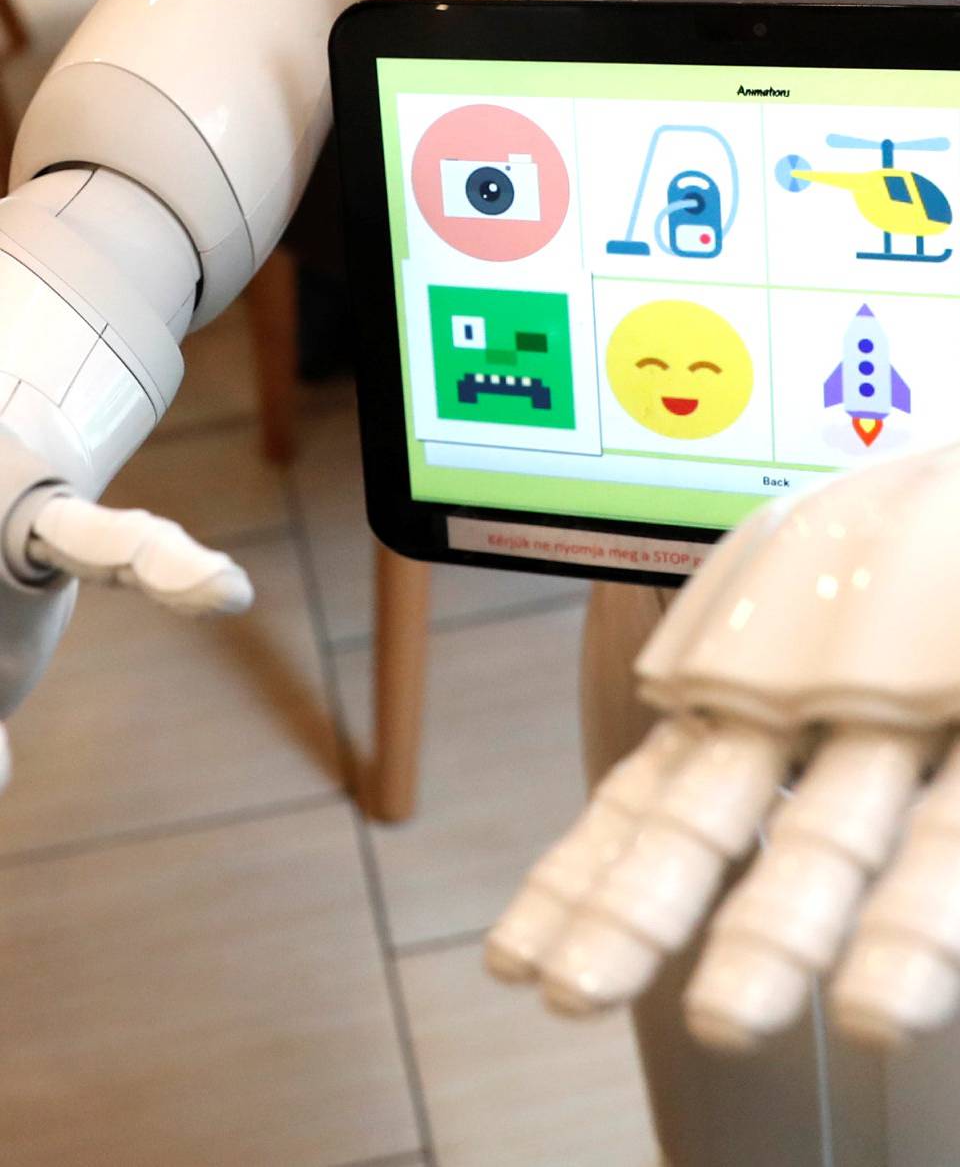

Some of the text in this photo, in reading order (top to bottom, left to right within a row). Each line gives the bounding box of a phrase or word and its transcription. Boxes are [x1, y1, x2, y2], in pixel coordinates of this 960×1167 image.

[763, 476, 790, 488] Back
[608, 547, 639, 563] meg
[653, 551, 690, 565] STOP
